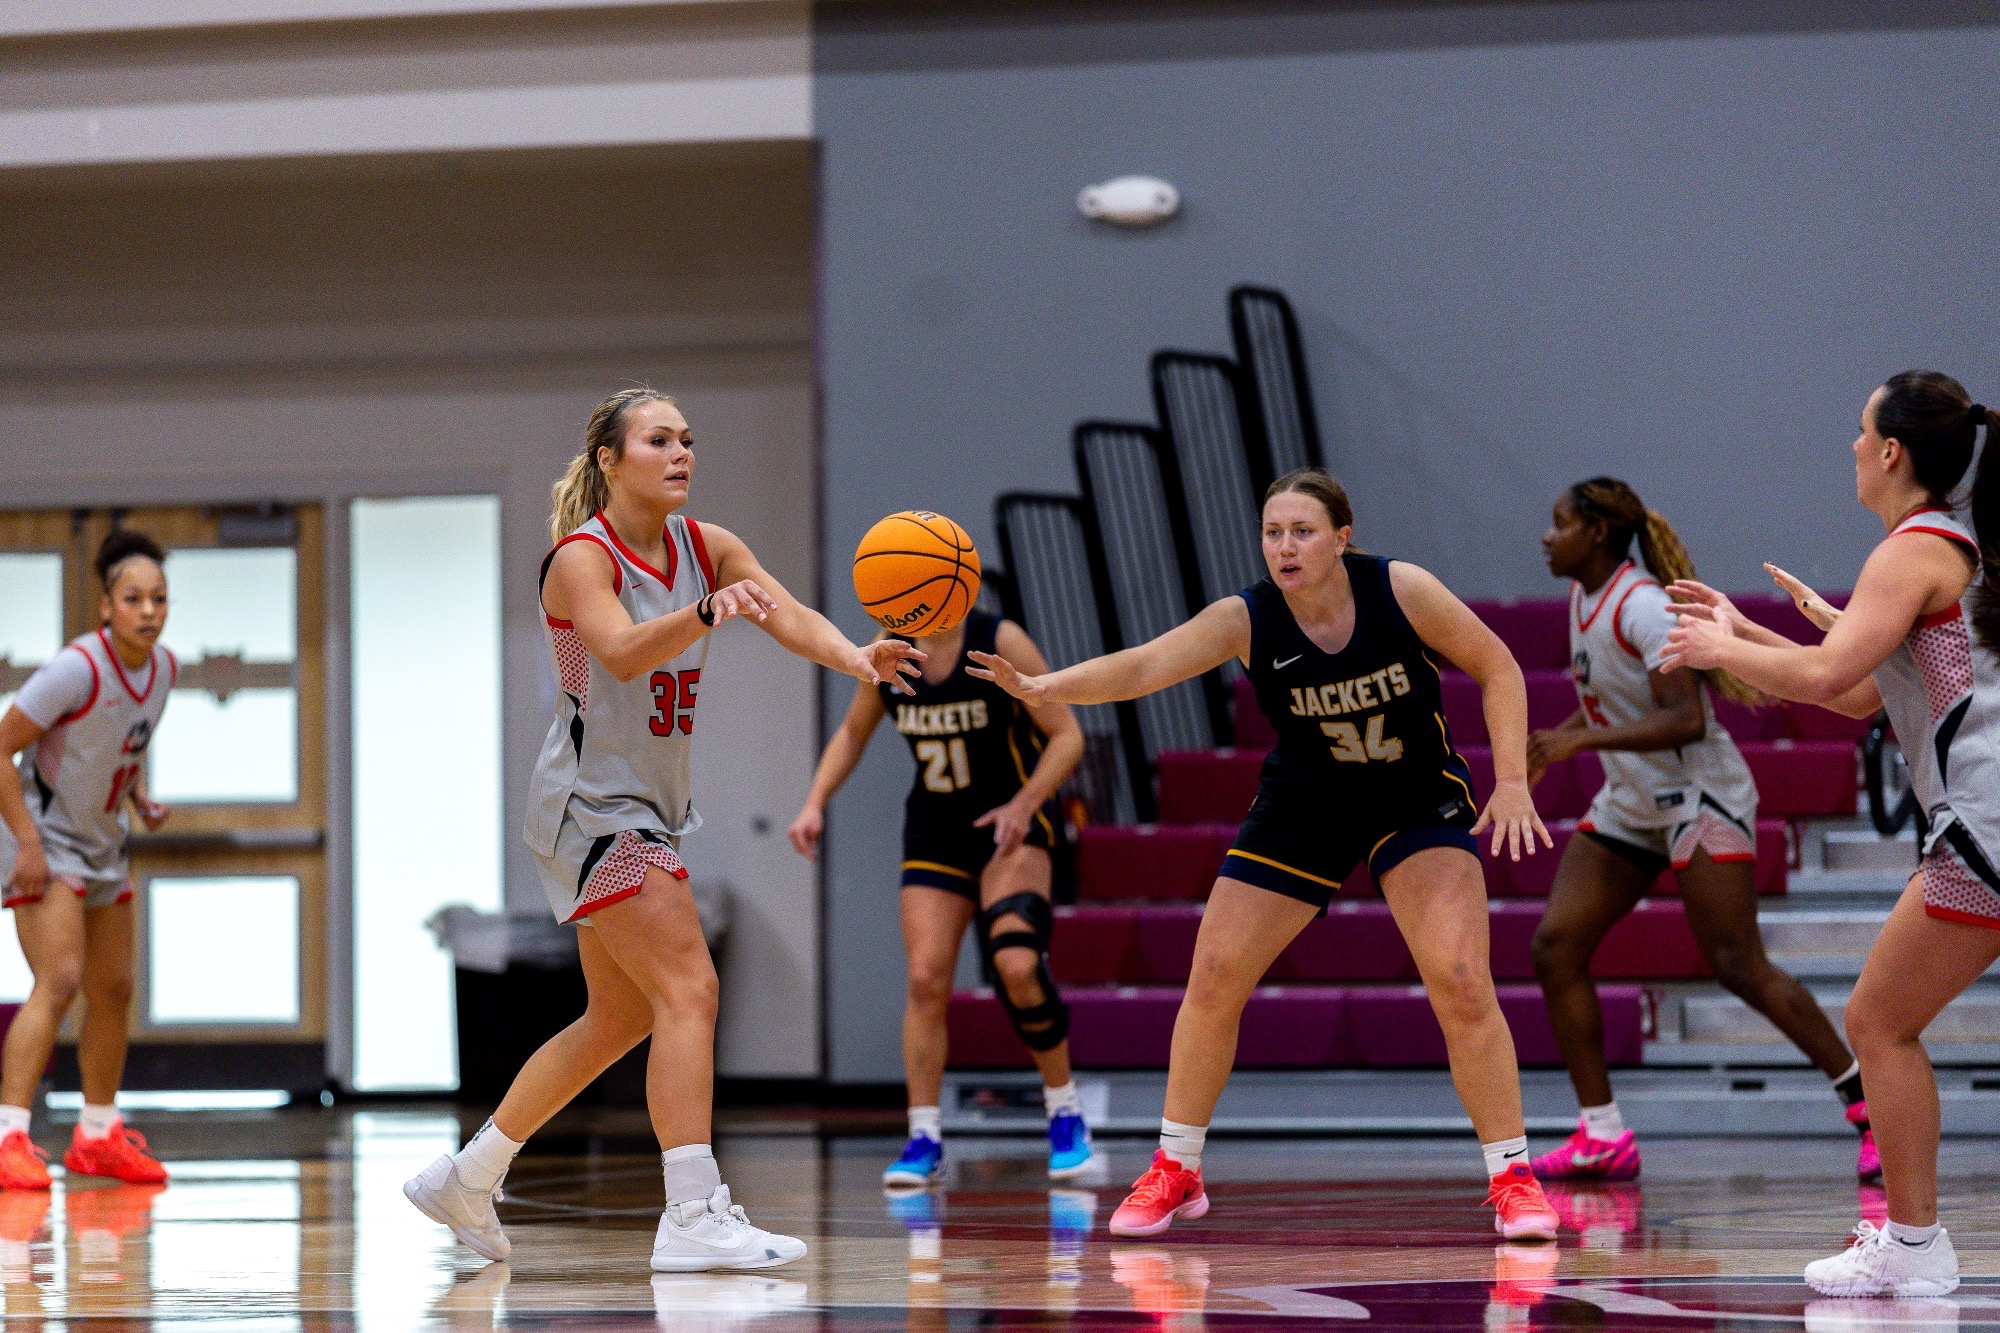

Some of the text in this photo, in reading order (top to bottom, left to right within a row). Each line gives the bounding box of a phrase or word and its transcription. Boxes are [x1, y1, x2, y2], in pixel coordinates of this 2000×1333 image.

[873, 602, 932, 629] ilson
[649, 668, 701, 737] 35
[1290, 663, 1411, 717] JACKETS
[896, 699, 989, 736] JACKETS
[1319, 714, 1404, 763] 34
[915, 737, 971, 793] 21
